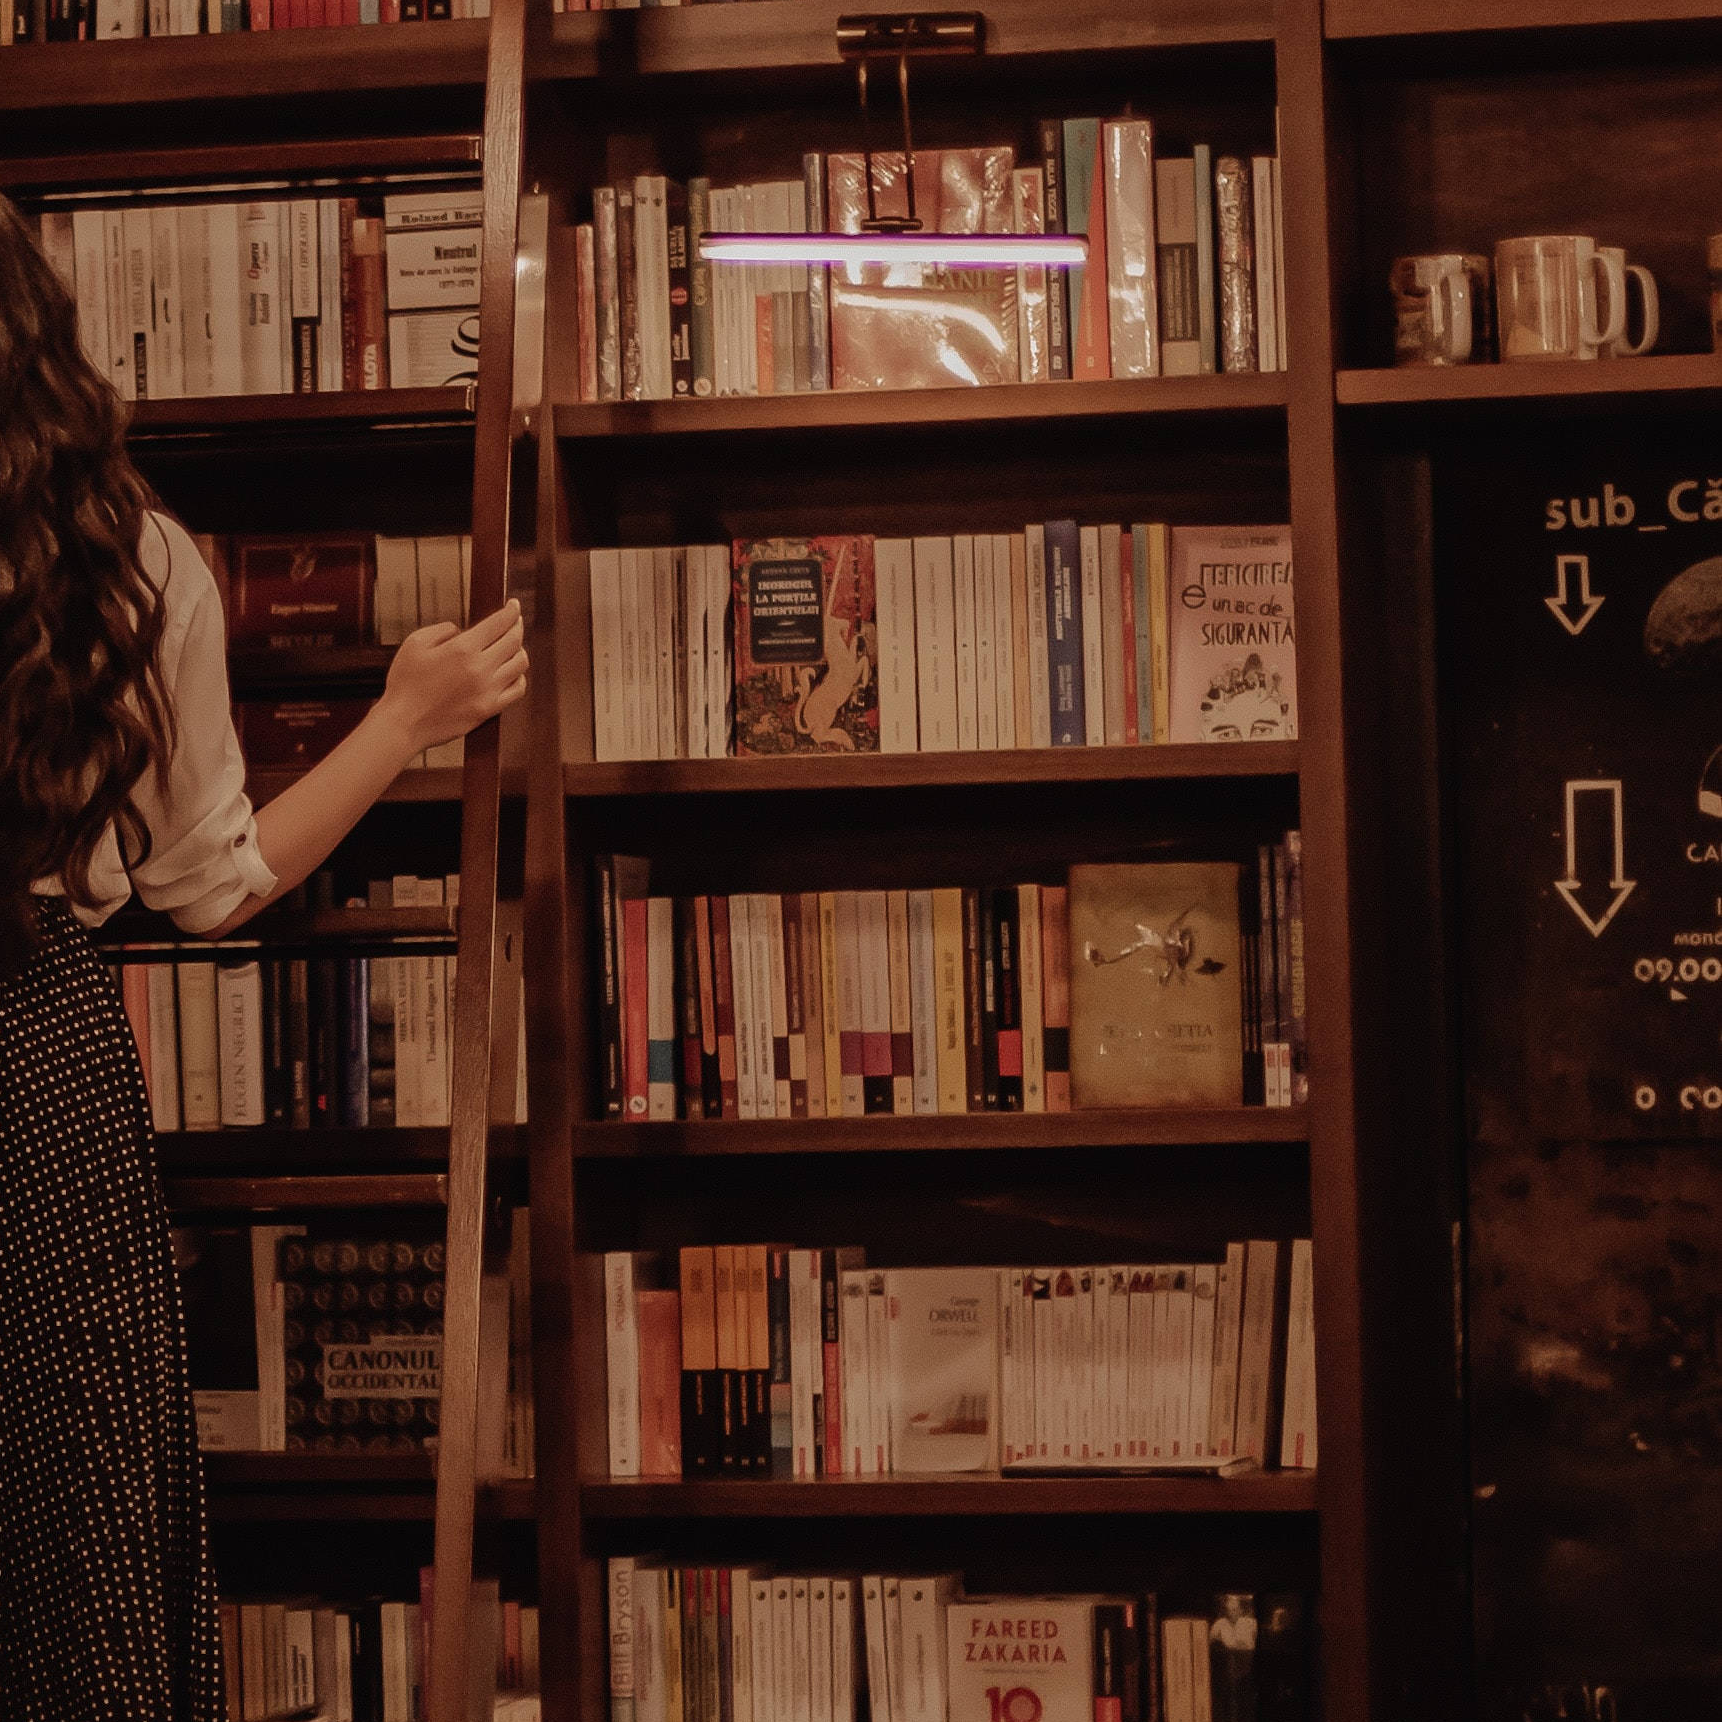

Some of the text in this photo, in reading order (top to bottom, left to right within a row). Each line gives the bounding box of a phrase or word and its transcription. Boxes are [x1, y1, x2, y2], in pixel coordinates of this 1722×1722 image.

[401, 211, 448, 225] Roland
[231, 992, 248, 1118] EUGEN NEGRICI
[327, 1350, 441, 1370] CANONUL
[327, 1373, 441, 1390] OCCIDENTAL
[612, 1570, 633, 1686] Bill Bryson
[971, 1618, 1059, 1639] FAREED
[964, 1642, 1067, 1664] ZAKARIA
